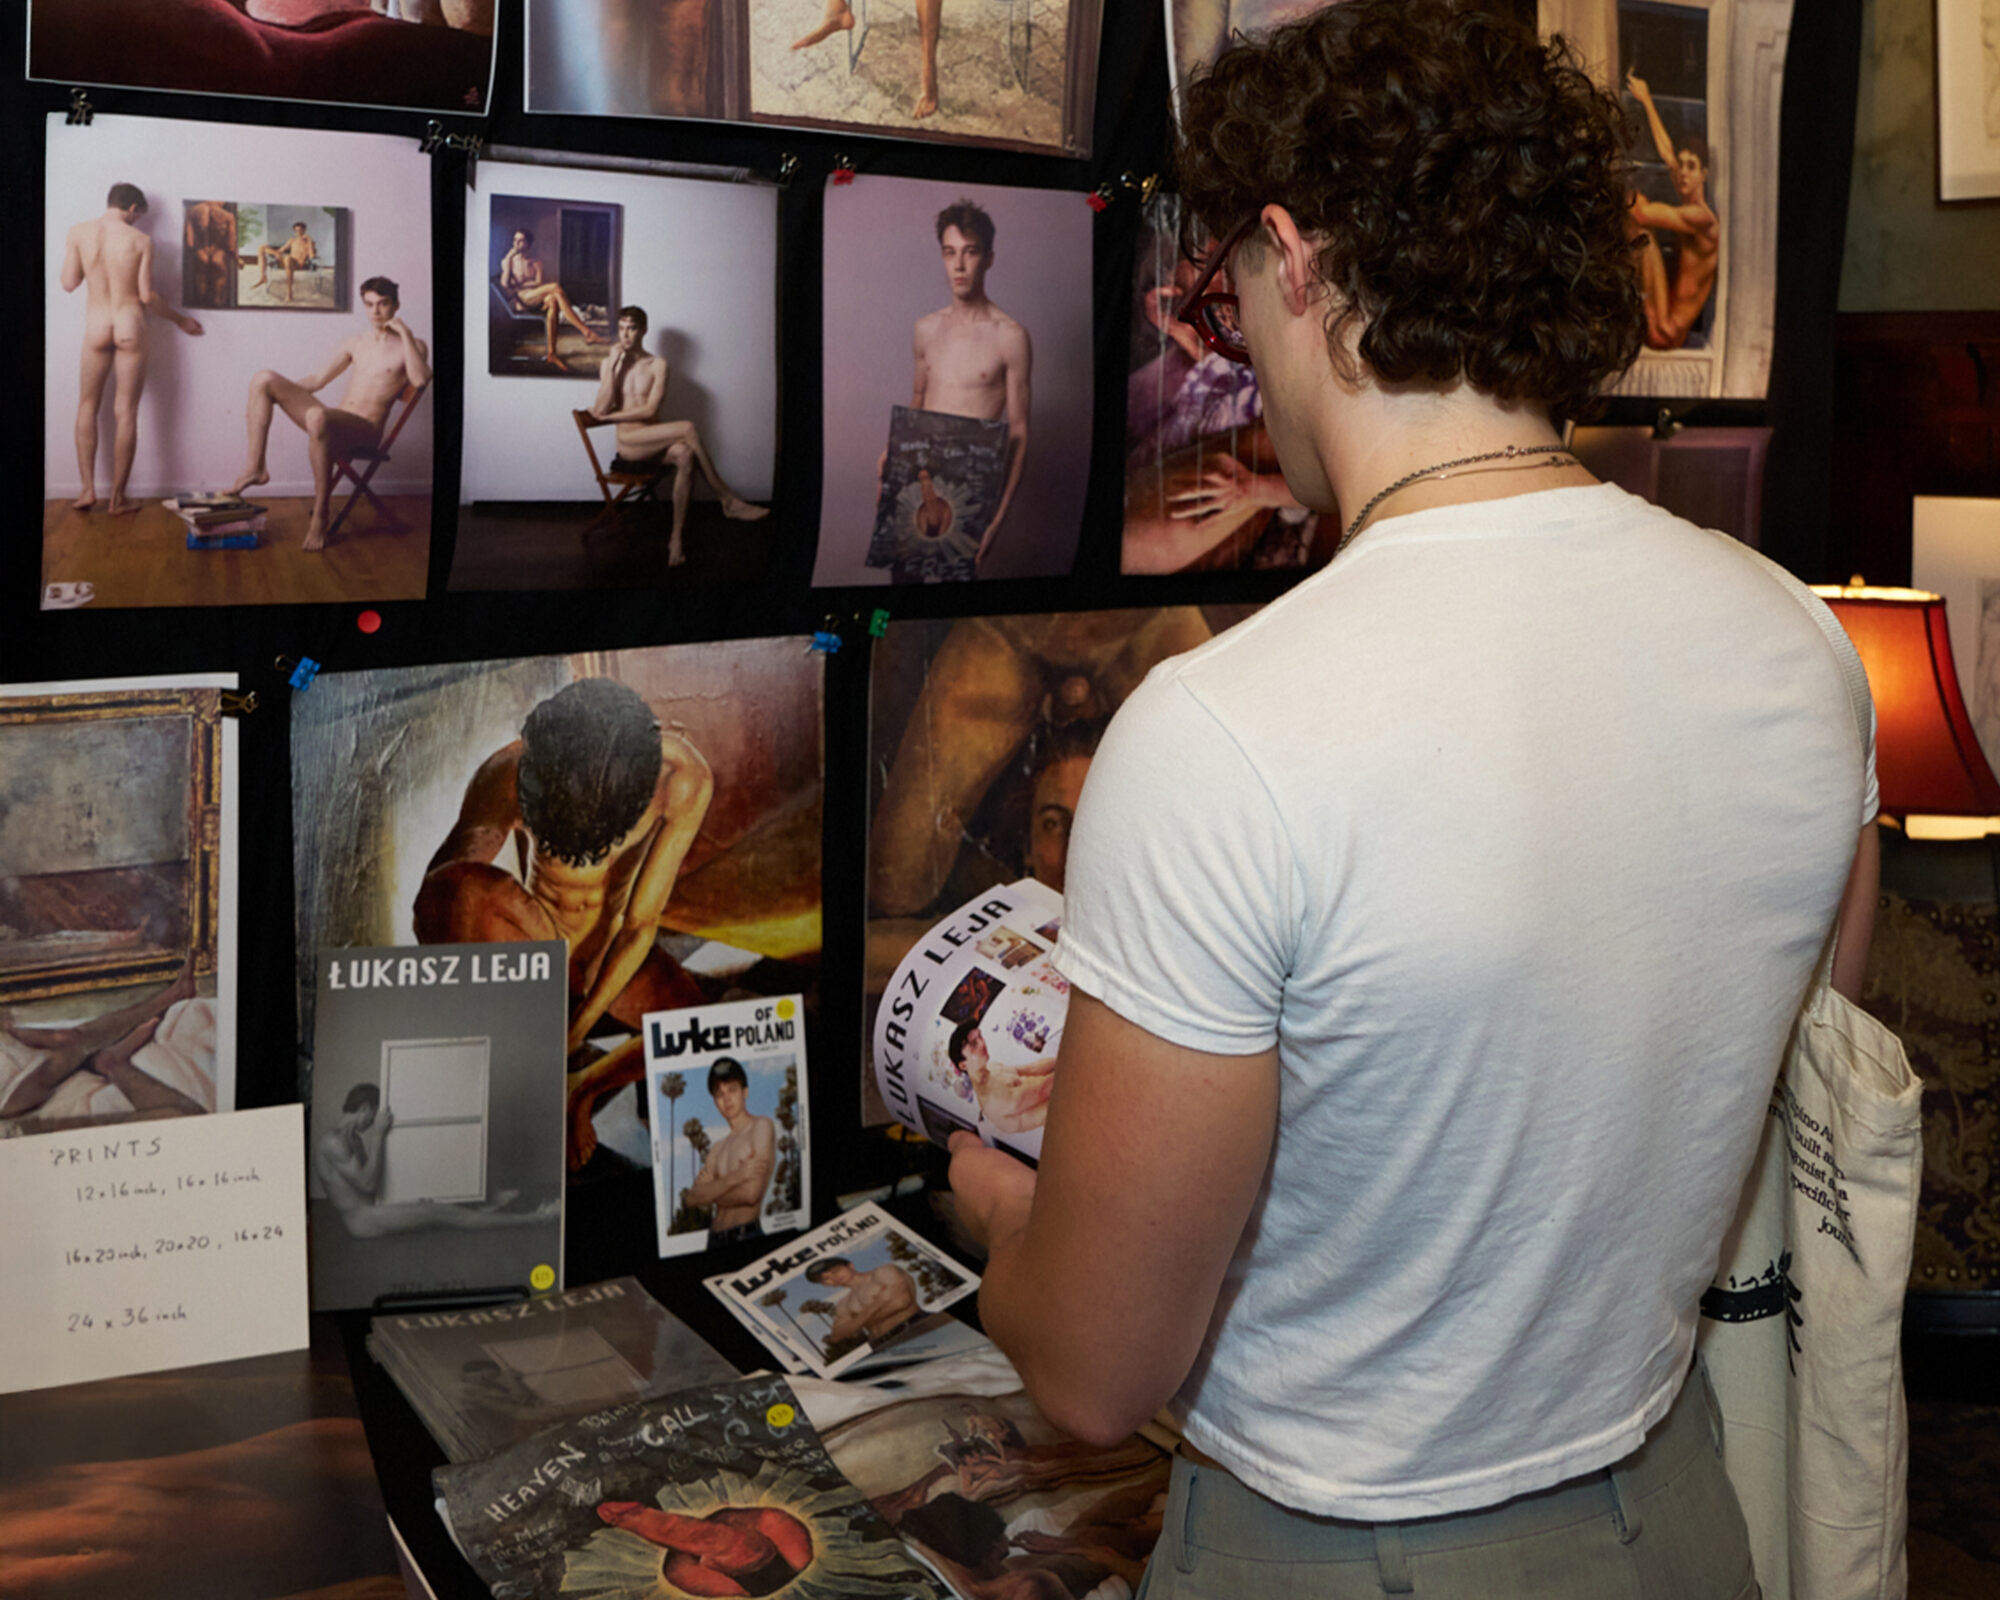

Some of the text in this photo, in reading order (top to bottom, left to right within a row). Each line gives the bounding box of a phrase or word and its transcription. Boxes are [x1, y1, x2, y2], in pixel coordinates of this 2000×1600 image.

[923, 899, 1014, 965] LEJA
[329, 951, 550, 990] ŁUKASZ LEJA
[755, 1006, 773, 1022] OF
[735, 1020, 795, 1048] POLAND
[50, 1137, 162, 1167] PRINTS
[1794, 1125, 1821, 1158] built
[1790, 1171, 1835, 1211] pecific
[815, 1214, 880, 1252] POLAND
[829, 1217, 848, 1233] OF
[156, 1303, 187, 1320] inch
[543, 1284, 626, 1311] LEJA
[484, 1441, 587, 1523] HEAVEN
[640, 1403, 709, 1448] CALL
